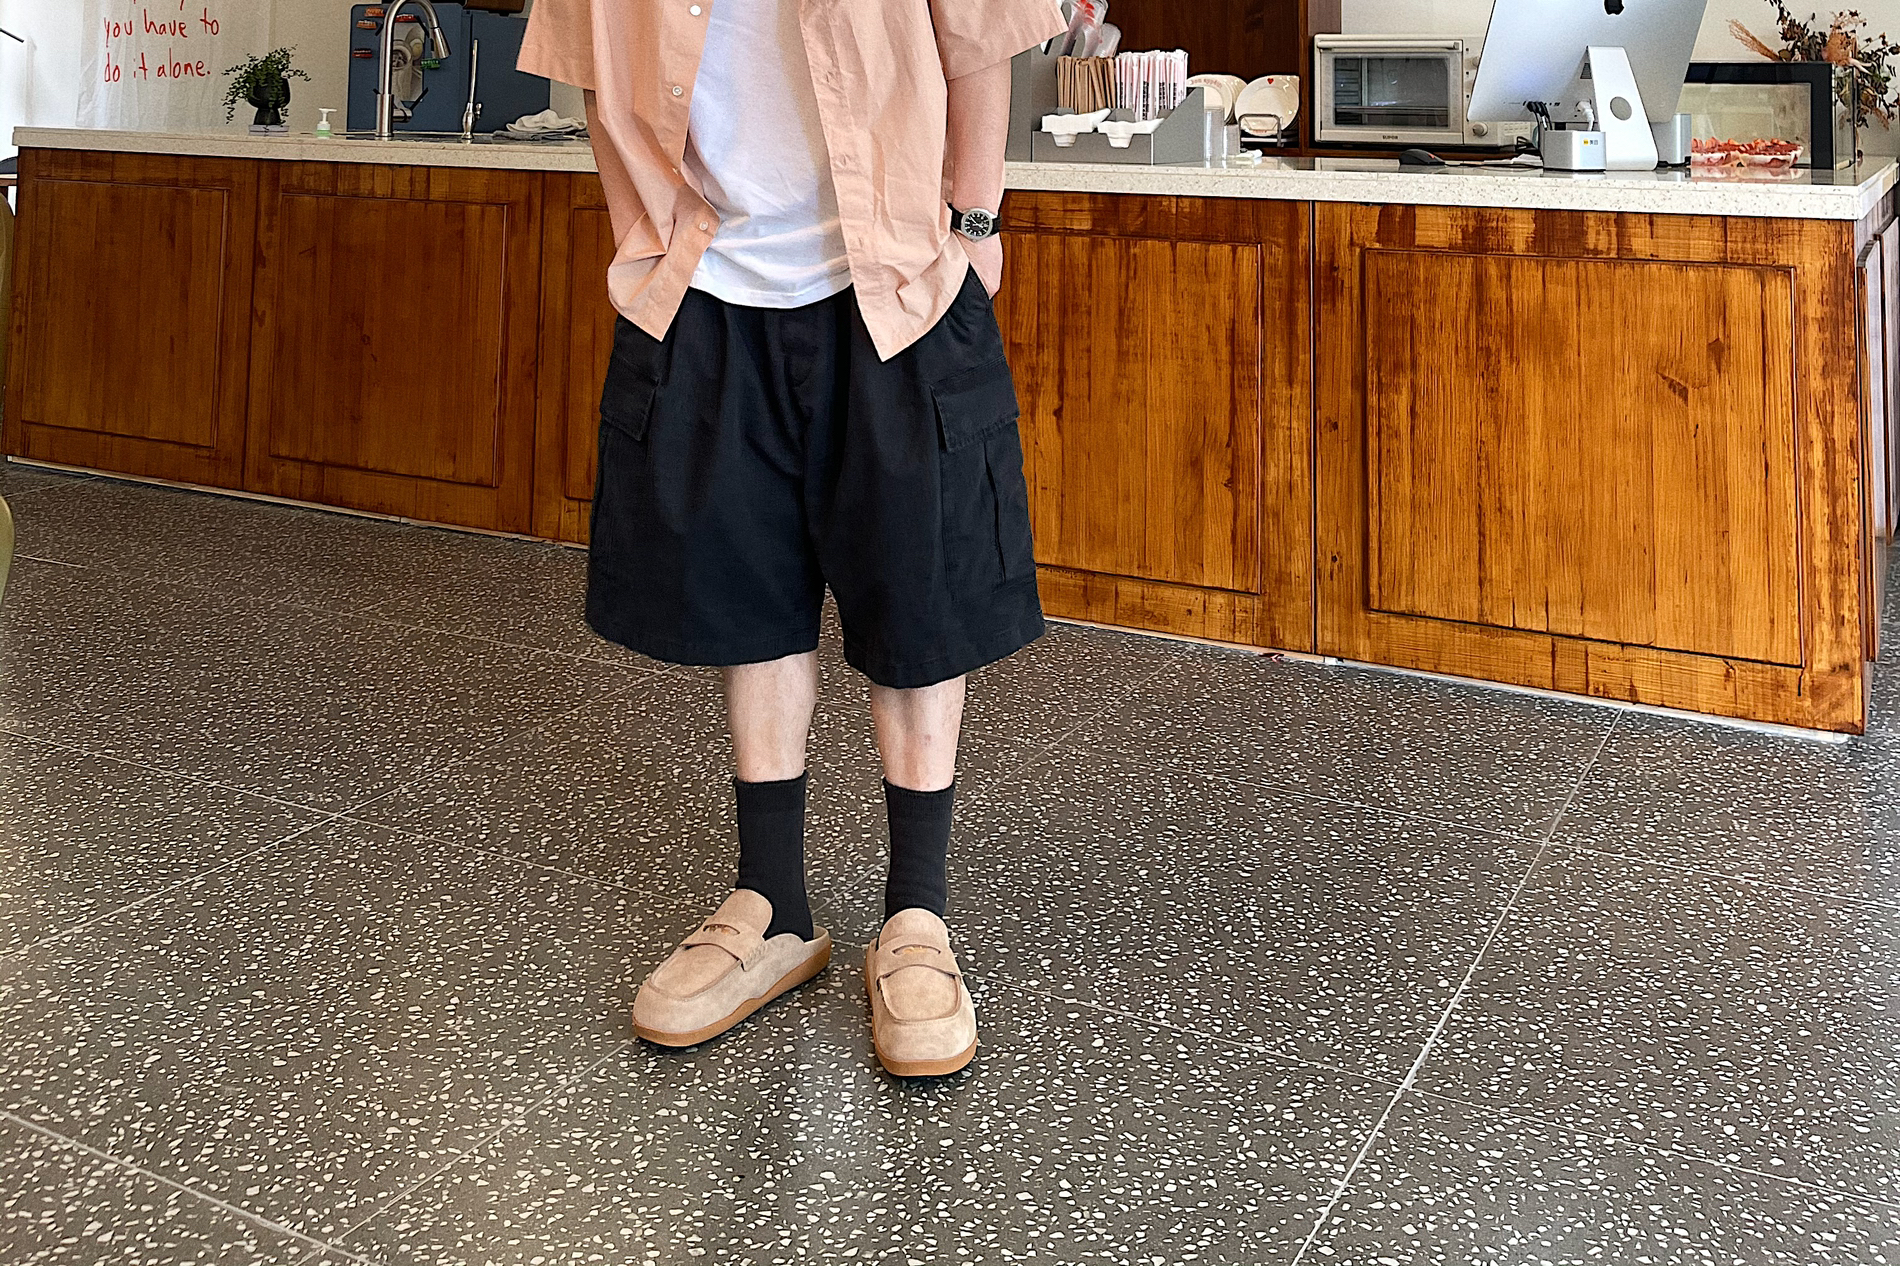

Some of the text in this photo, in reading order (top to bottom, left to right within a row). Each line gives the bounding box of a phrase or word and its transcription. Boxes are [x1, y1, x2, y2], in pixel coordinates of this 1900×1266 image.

[103, 8, 219, 47] you have to
[104, 47, 210, 82] do it alone.
